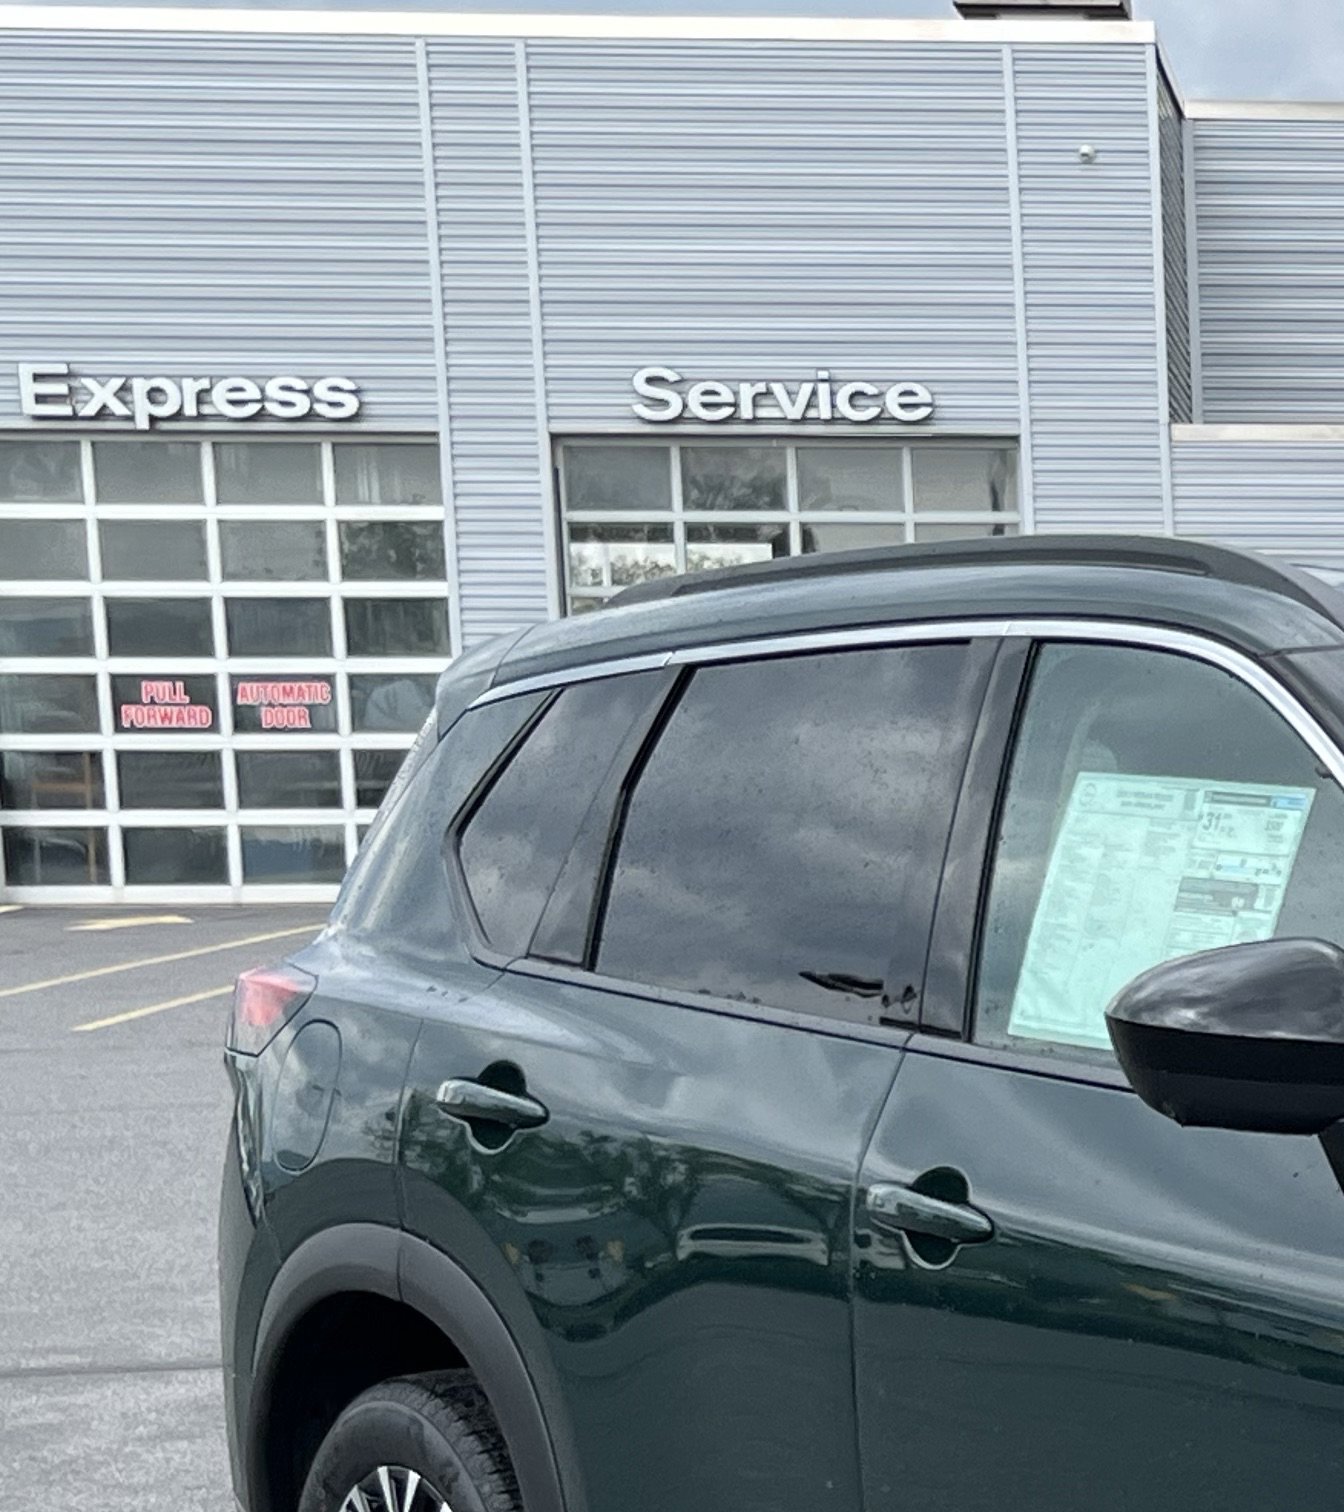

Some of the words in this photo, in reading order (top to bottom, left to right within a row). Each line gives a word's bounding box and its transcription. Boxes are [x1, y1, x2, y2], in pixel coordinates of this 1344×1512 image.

[17, 363, 361, 430] Express
[631, 365, 936, 424] Service
[141, 680, 190, 704] PULL
[237, 682, 331, 705] AUTOMATIC
[121, 704, 213, 728] FORWARD
[261, 706, 311, 728] DOOR
